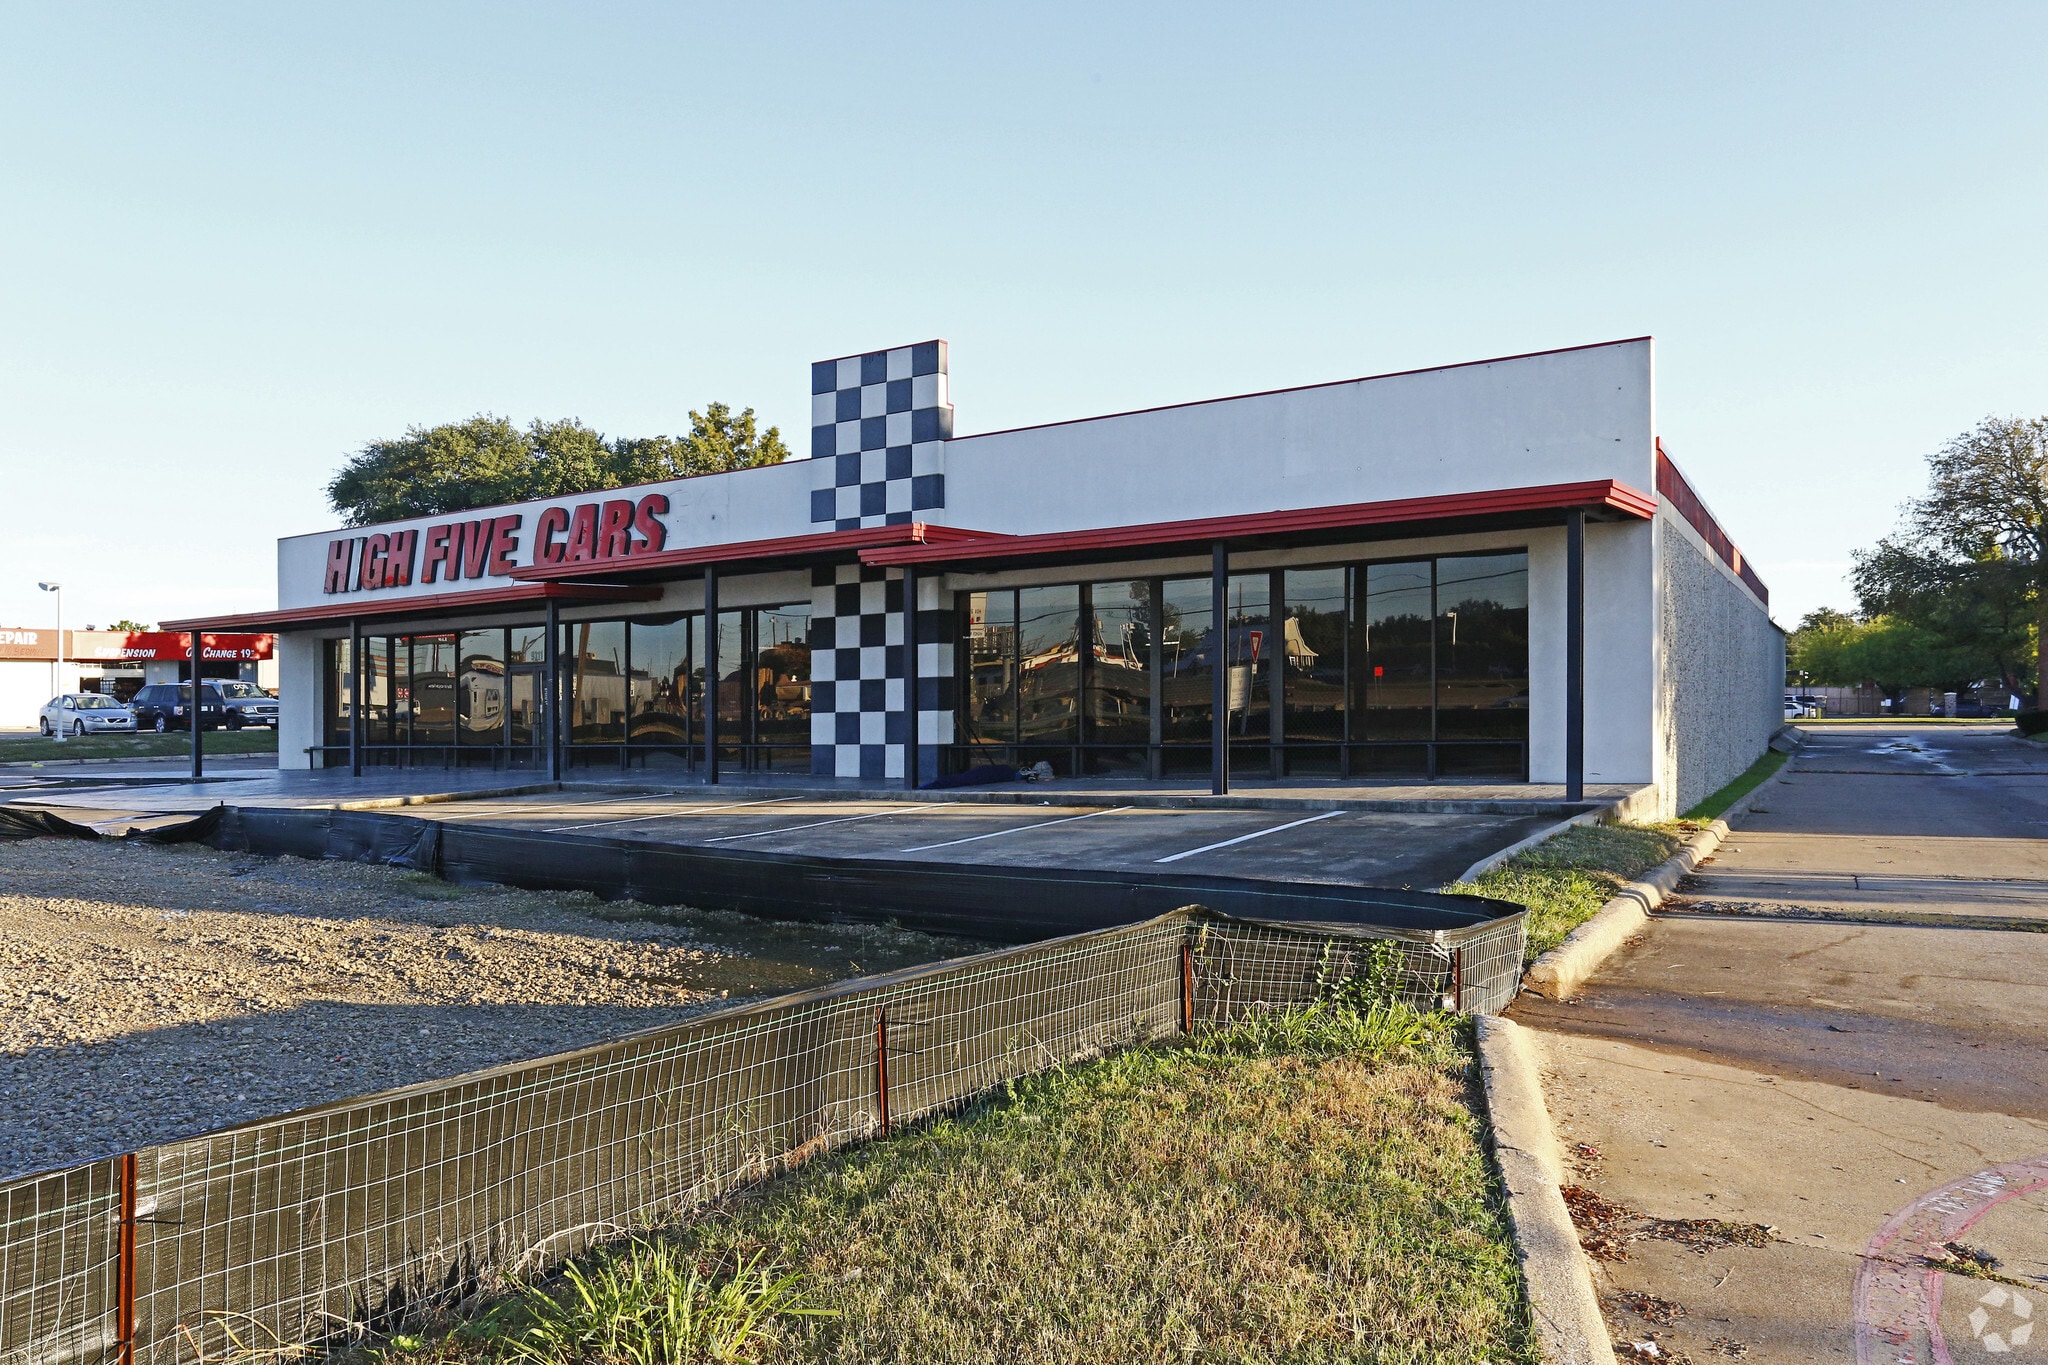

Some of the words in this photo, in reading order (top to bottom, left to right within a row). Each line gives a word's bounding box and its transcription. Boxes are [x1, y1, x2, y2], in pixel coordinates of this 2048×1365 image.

[324, 529, 418, 594] HIGH
[421, 514, 522, 583] FIVE
[534, 493, 670, 564] CARS
[94, 646, 156, 658] SUSPENSION
